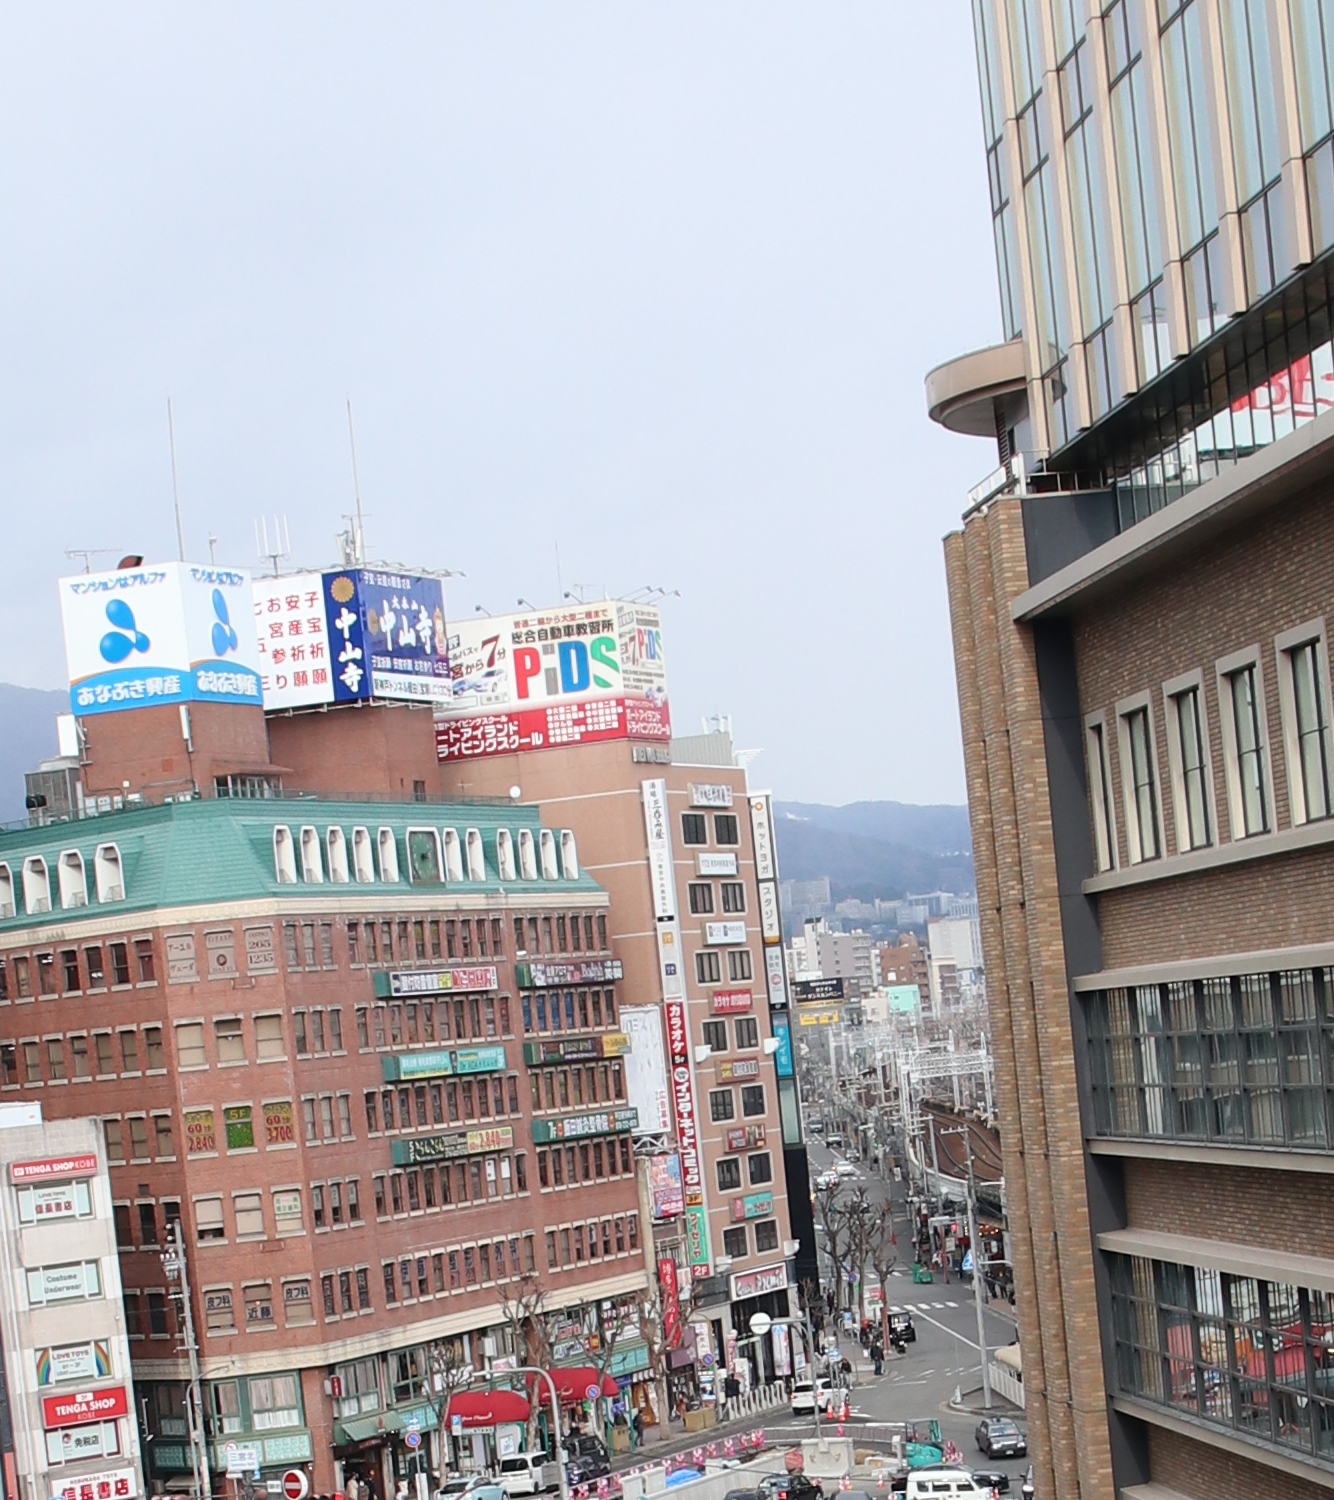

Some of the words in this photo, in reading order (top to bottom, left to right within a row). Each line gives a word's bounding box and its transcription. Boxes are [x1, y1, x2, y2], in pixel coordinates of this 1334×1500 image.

[69, 571, 167, 594] マンションはアルファ
[266, 597, 289, 689] お宮参り
[284, 594, 309, 688] 安産祈願
[304, 591, 328, 685] 子宝祈願
[379, 598, 433, 655] 中山寺
[511, 619, 614, 645] 総合自動車教習所
[334, 607, 364, 694] 中山寺
[513, 636, 620, 700] PiDS
[76, 674, 182, 707] あなぶき興産
[757, 821, 770, 875] ホットヨガ
[763, 886, 775, 932] スタジオ
[670, 1004, 685, 1053] カラオケ
[229, 1109, 247, 1118] 5F
[25, 1164, 52, 1175] TENGA
[52, 1161, 75, 1172] SHOP
[46, 1273, 78, 1284] Costume
[693, 1265, 708, 1276] 2F
[54, 1403, 88, 1417] TENGA
[89, 1398, 116, 1412] SHOP
[74, 1435, 100, 1449] 免税店
